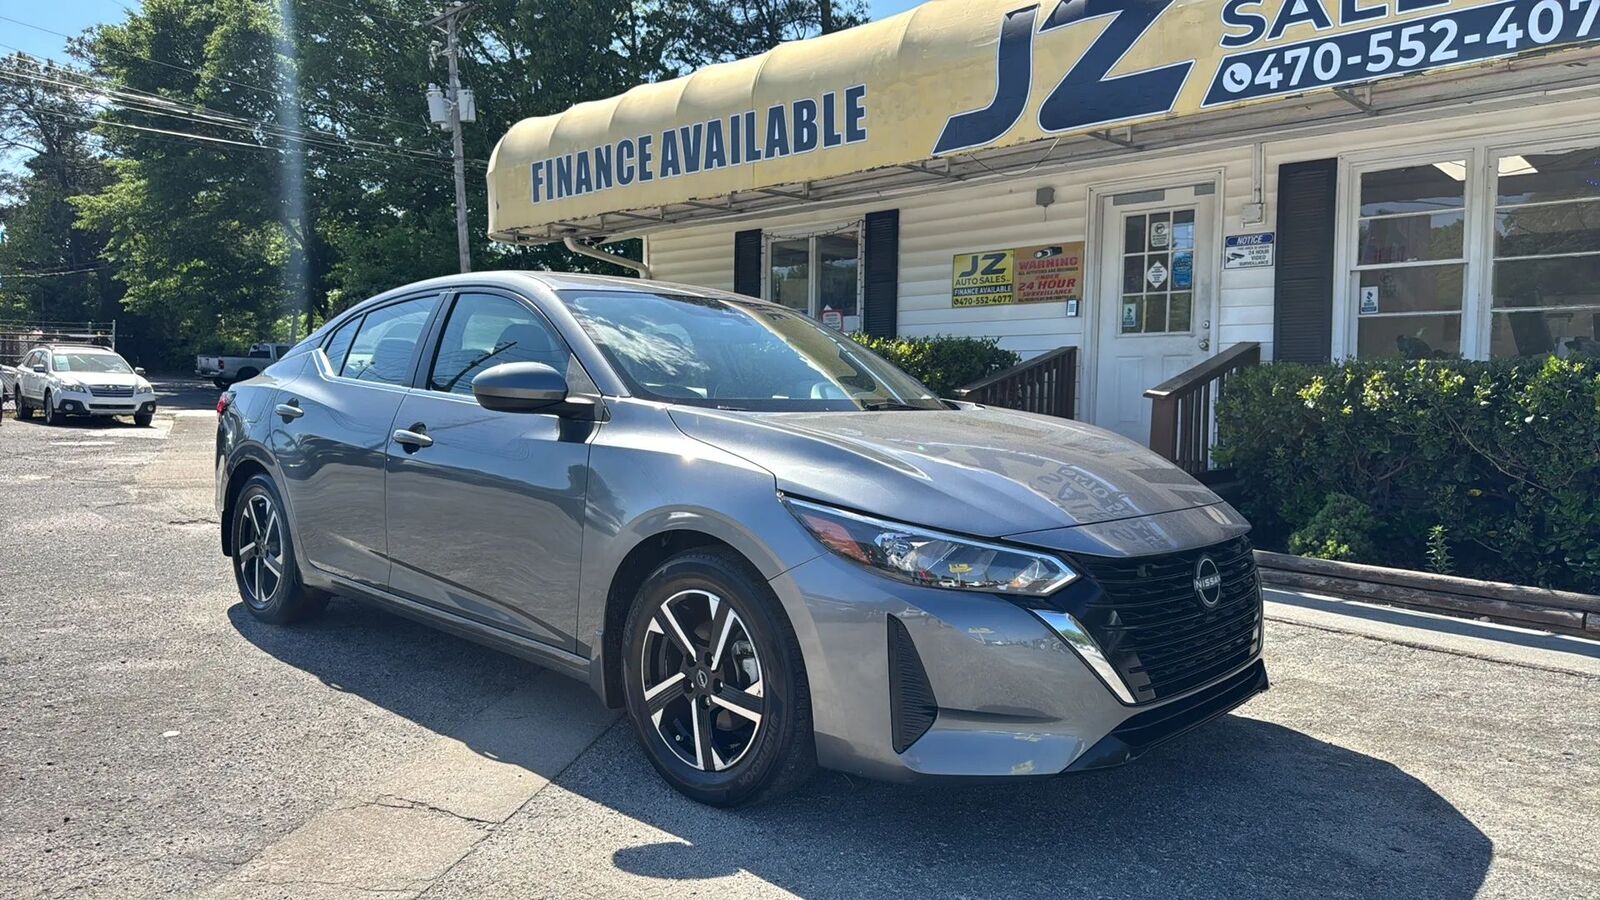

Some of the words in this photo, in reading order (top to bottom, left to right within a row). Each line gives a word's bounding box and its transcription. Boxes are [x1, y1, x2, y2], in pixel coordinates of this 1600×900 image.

[1219, 0, 1452, 48] SAL
[931, 0, 1196, 157] JZ
[531, 133, 653, 204] FINANCE
[659, 84, 867, 179] AVAILABLE
[1236, 235, 1263, 245] NOTICE
[959, 253, 1007, 278] JZ
[1018, 257, 1078, 270] WARNING
[955, 278, 978, 286] AUTO
[979, 275, 1006, 284] SALES
[1018, 281, 1034, 292] 24
[1038, 278, 1076, 290] HOUR
[954, 287, 979, 295] FINANCE
[980, 284, 1012, 293] AVAILABLE
[1023, 289, 1073, 298] SURVEILLANCE
[959, 295, 1012, 305] 470-552-4077
[1194, 575, 1221, 589] NISSAN
